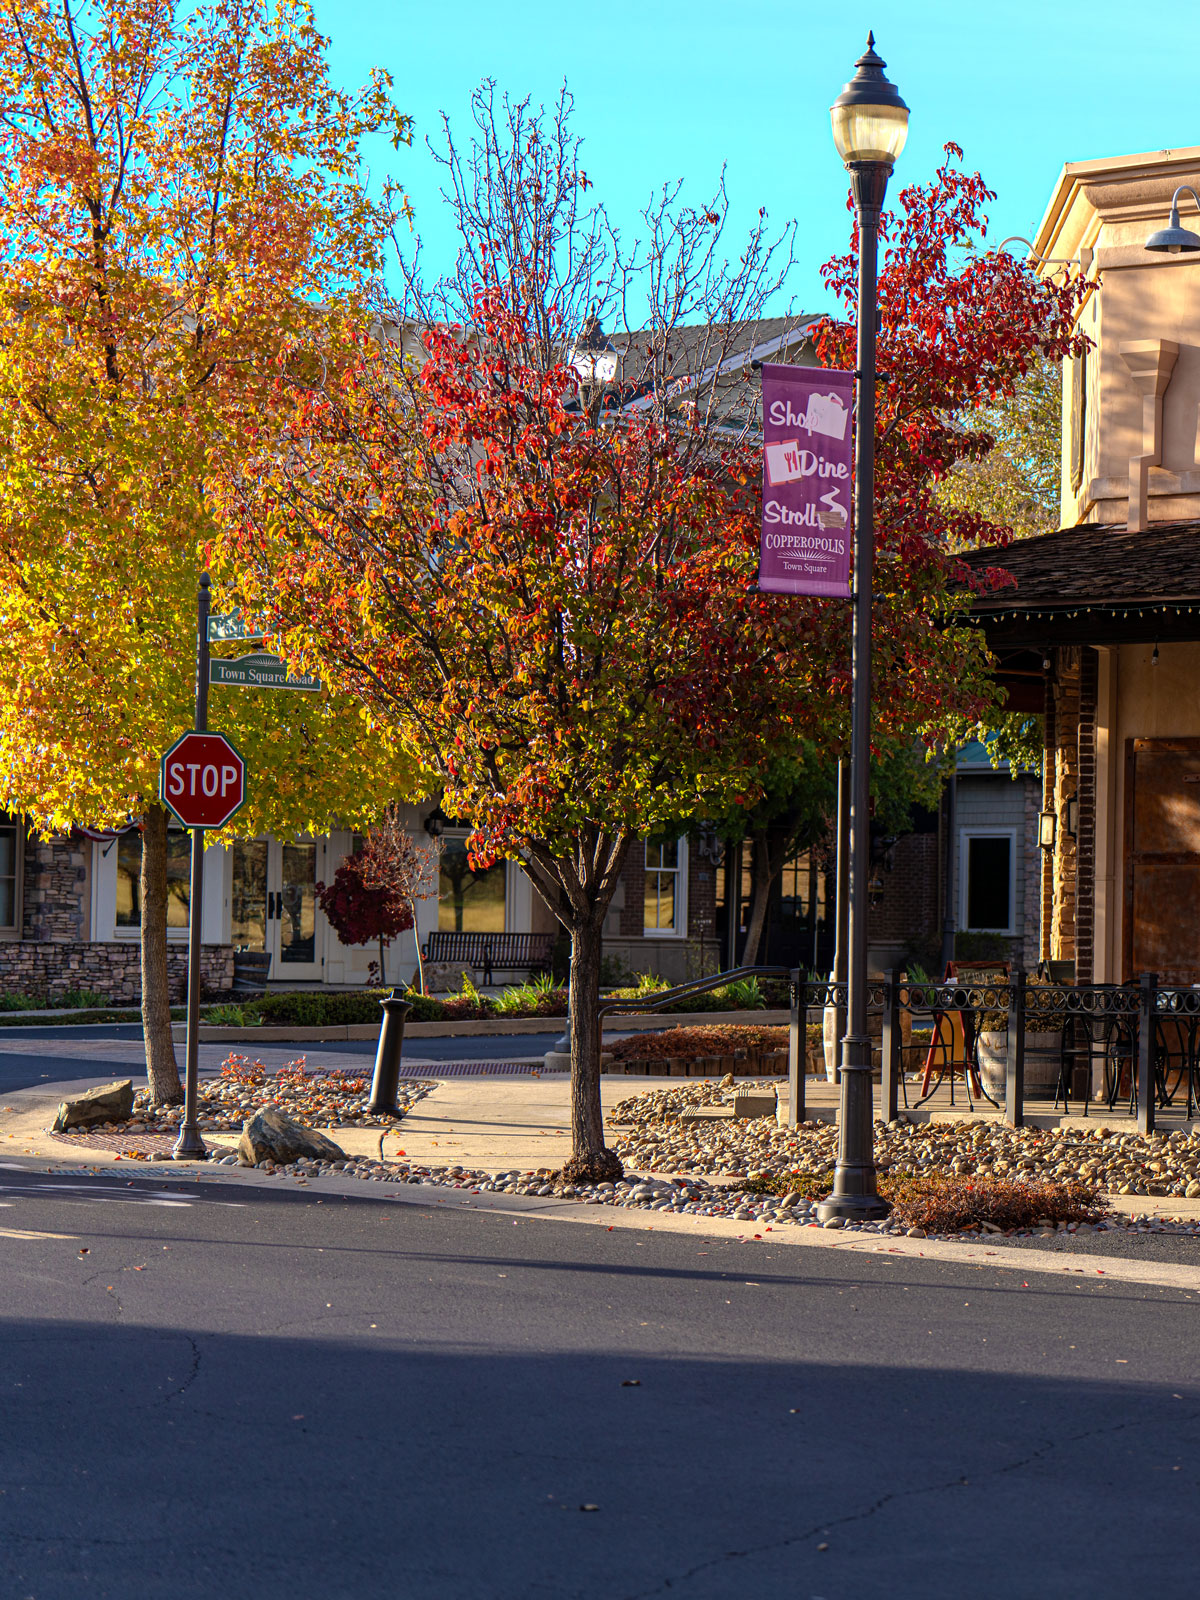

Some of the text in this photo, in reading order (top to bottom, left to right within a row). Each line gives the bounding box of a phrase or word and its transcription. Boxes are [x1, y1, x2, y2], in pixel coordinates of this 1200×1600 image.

[798, 449, 850, 479] Dine
[763, 500, 818, 527] Stroll
[765, 533, 845, 555] COPPEROPOLIS
[782, 561, 828, 574] Town Square
[218, 666, 246, 680] Town
[248, 669, 285, 683] Square
[169, 762, 238, 797] STOP
